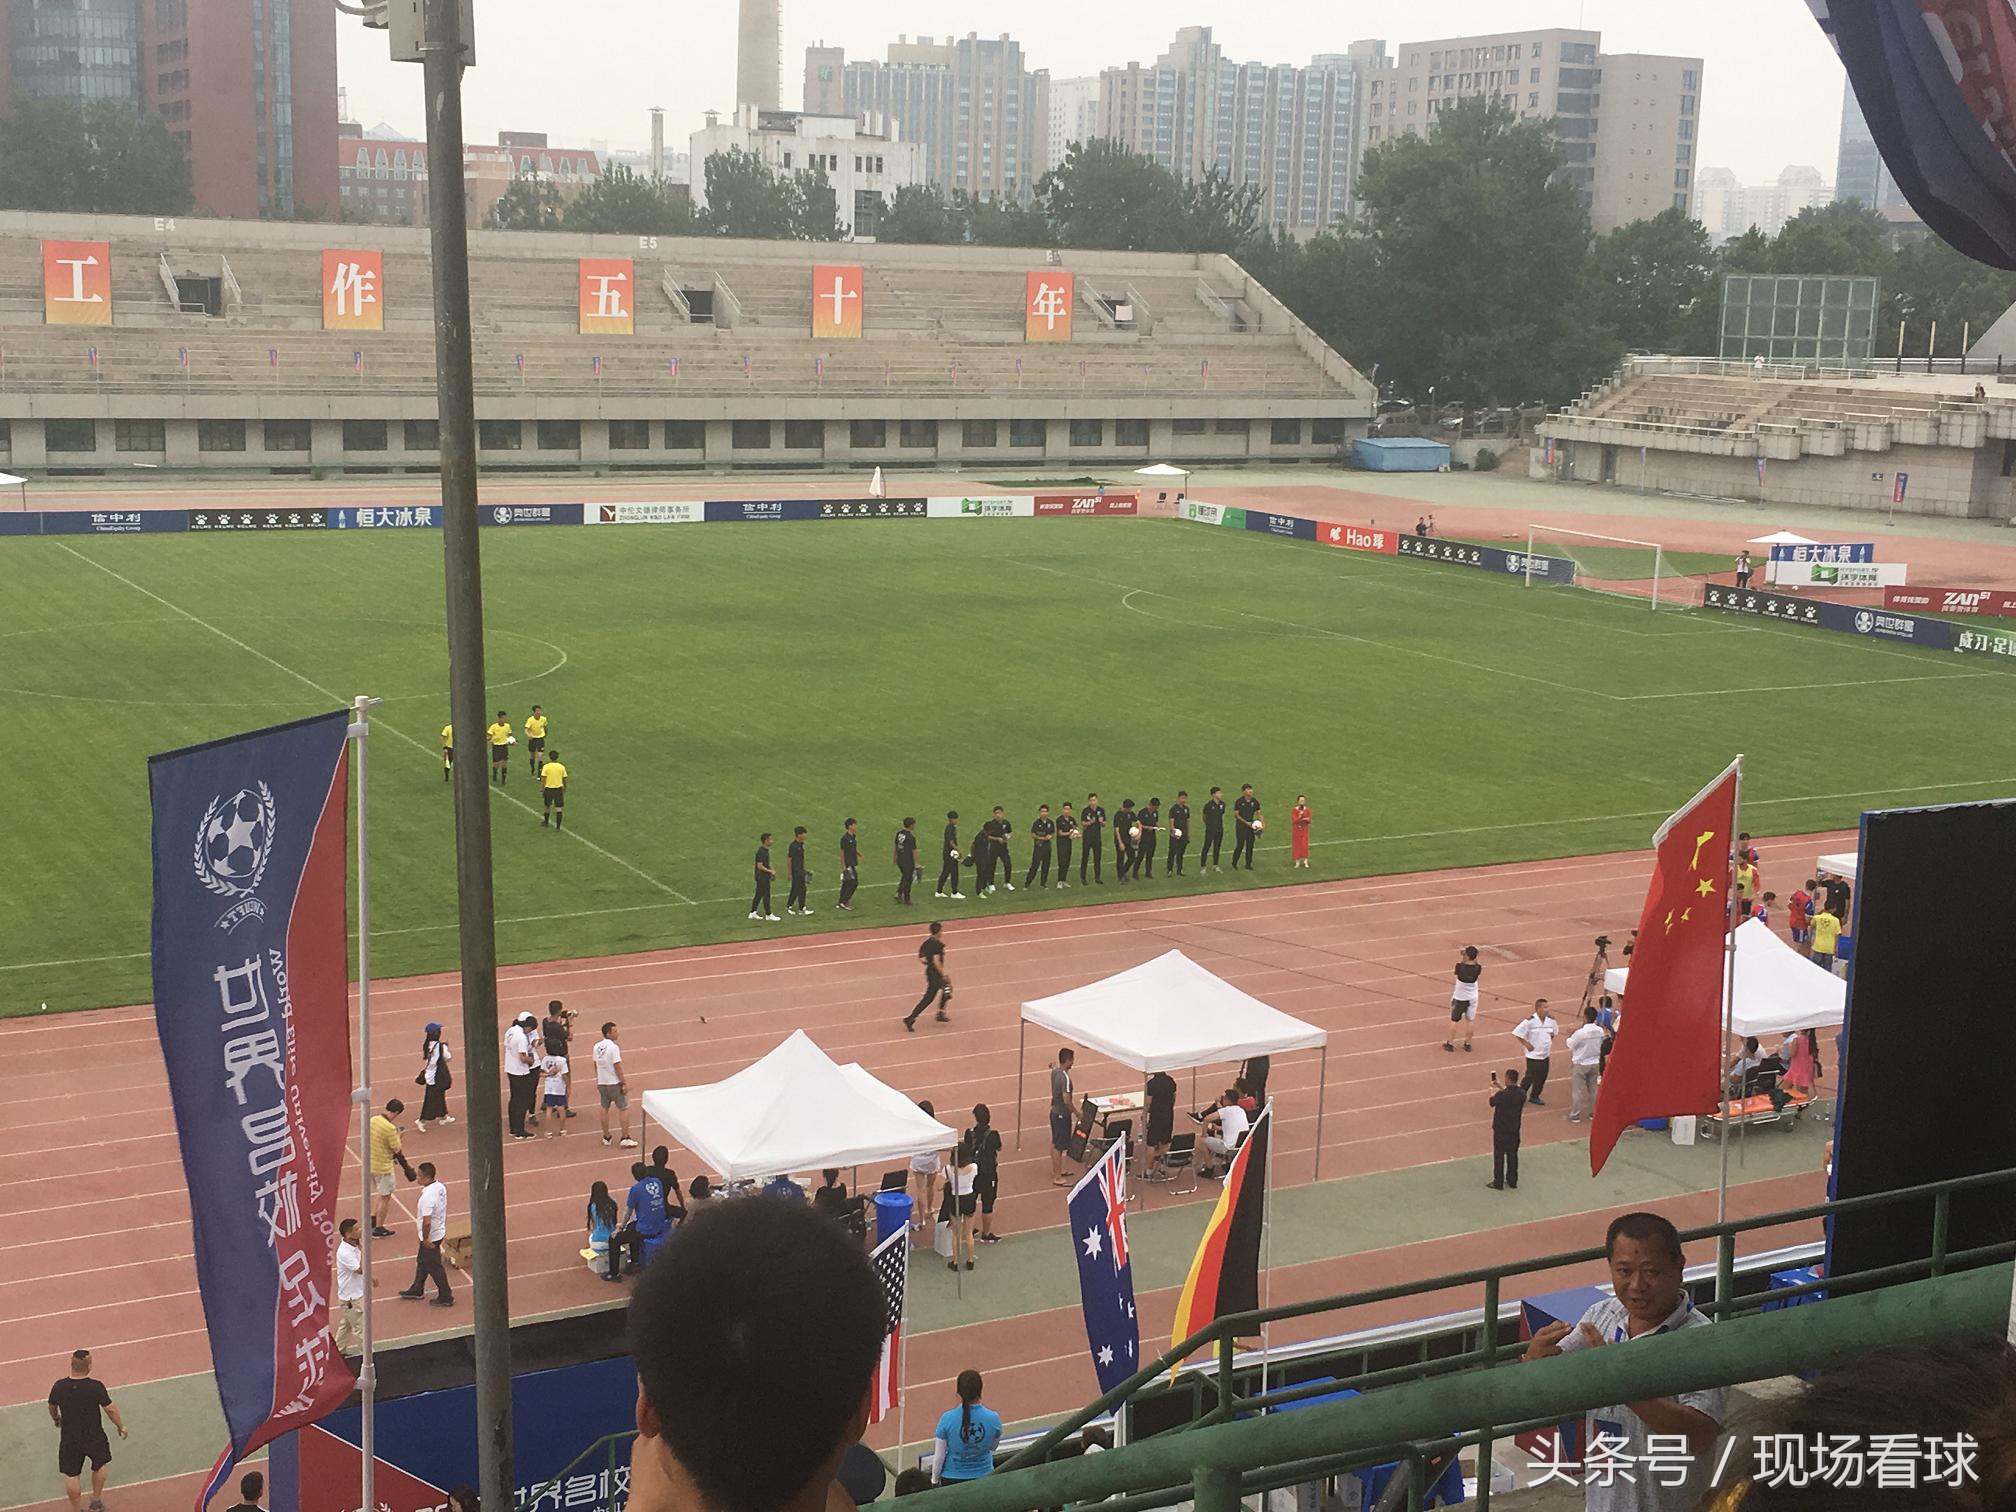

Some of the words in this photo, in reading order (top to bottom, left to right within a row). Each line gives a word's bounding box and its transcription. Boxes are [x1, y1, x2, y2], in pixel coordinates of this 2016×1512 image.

[154, 218, 176, 231] E4
[639, 236, 657, 249] E5
[54, 255, 103, 302] 工
[330, 261, 377, 317] 作
[585, 272, 629, 318] 五
[819, 275, 858, 325] 十
[1031, 282, 1068, 331] 年
[91, 513, 141, 522] 信中利
[356, 507, 432, 528] 恒大冰泉
[1792, 546, 1852, 563] 恒大冰泉
